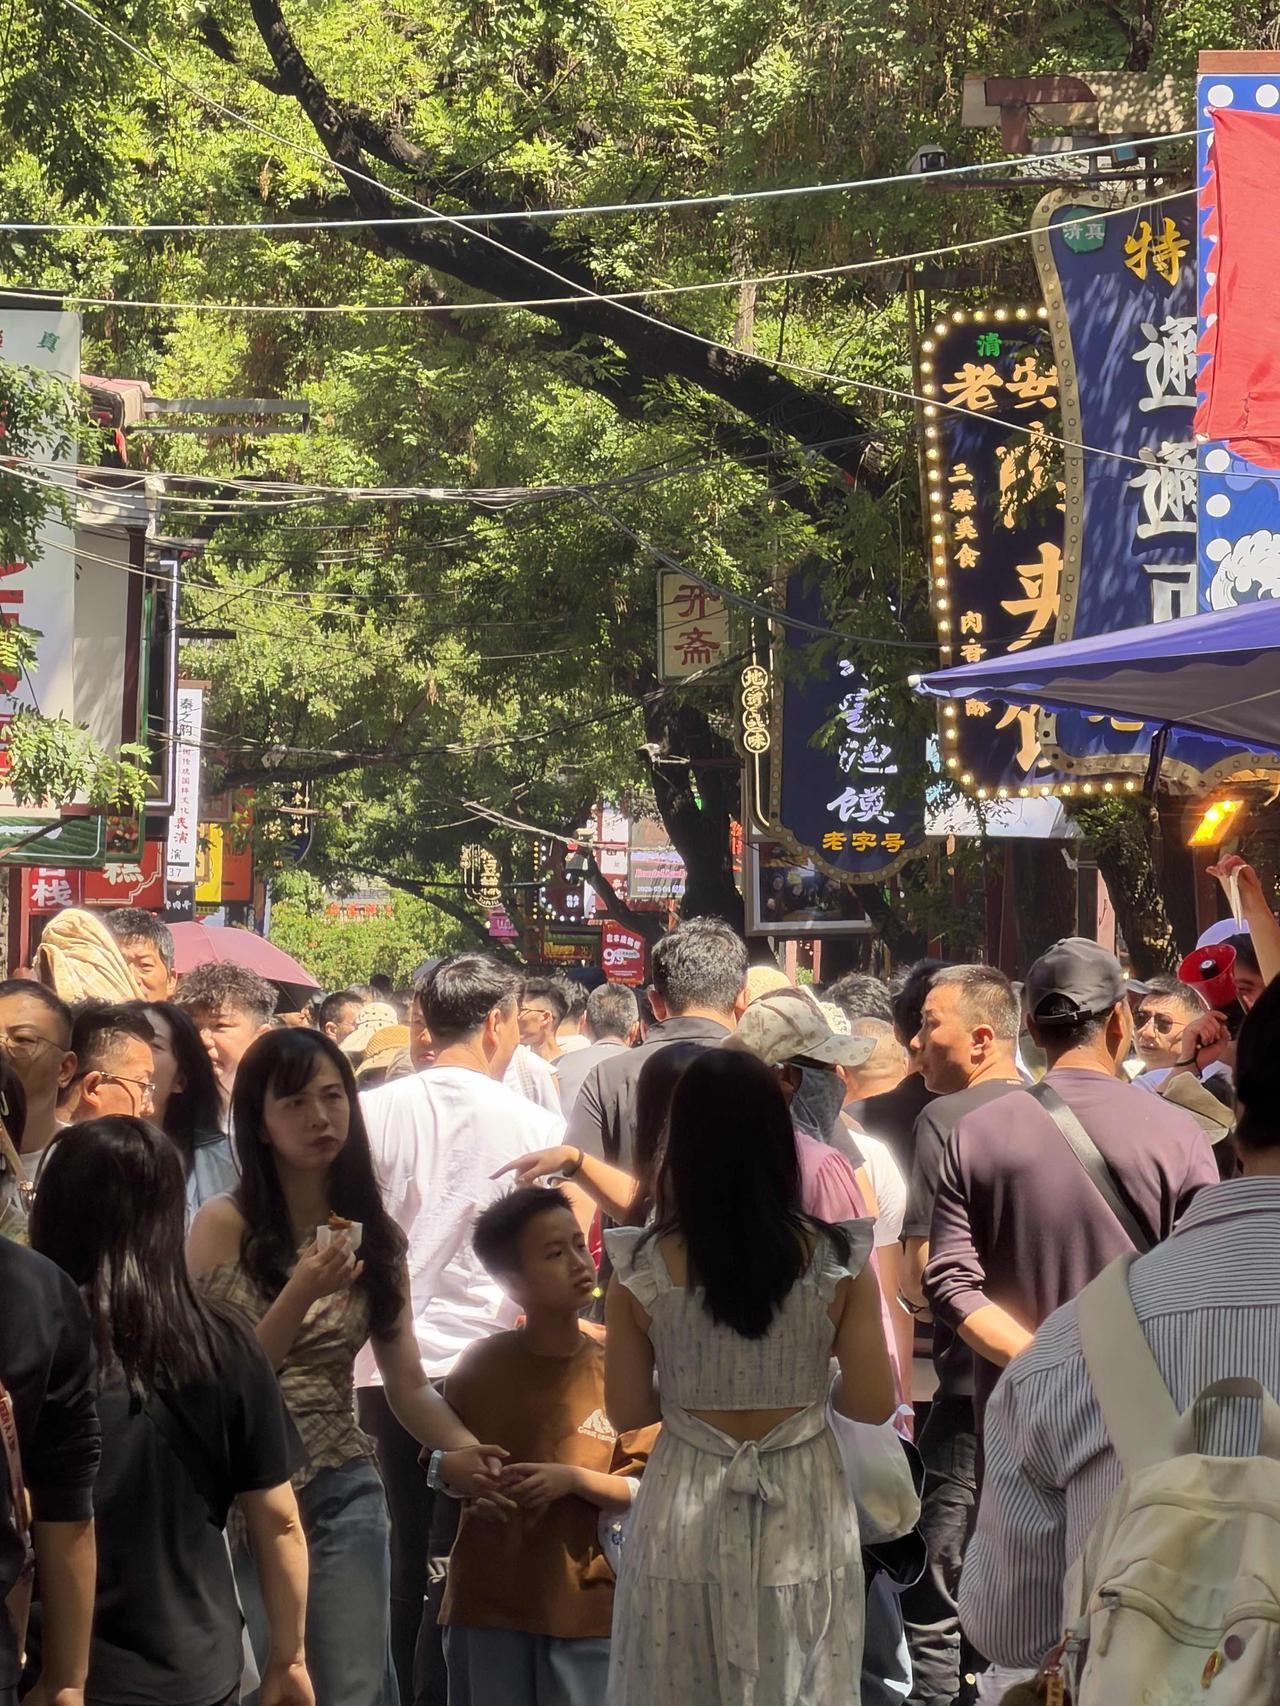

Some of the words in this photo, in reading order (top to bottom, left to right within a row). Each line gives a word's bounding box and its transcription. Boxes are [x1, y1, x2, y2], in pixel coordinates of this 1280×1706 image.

[1124, 216, 1191, 286] 特
[976, 332, 1002, 357] 清
[822, 831, 906, 853] 老字号
